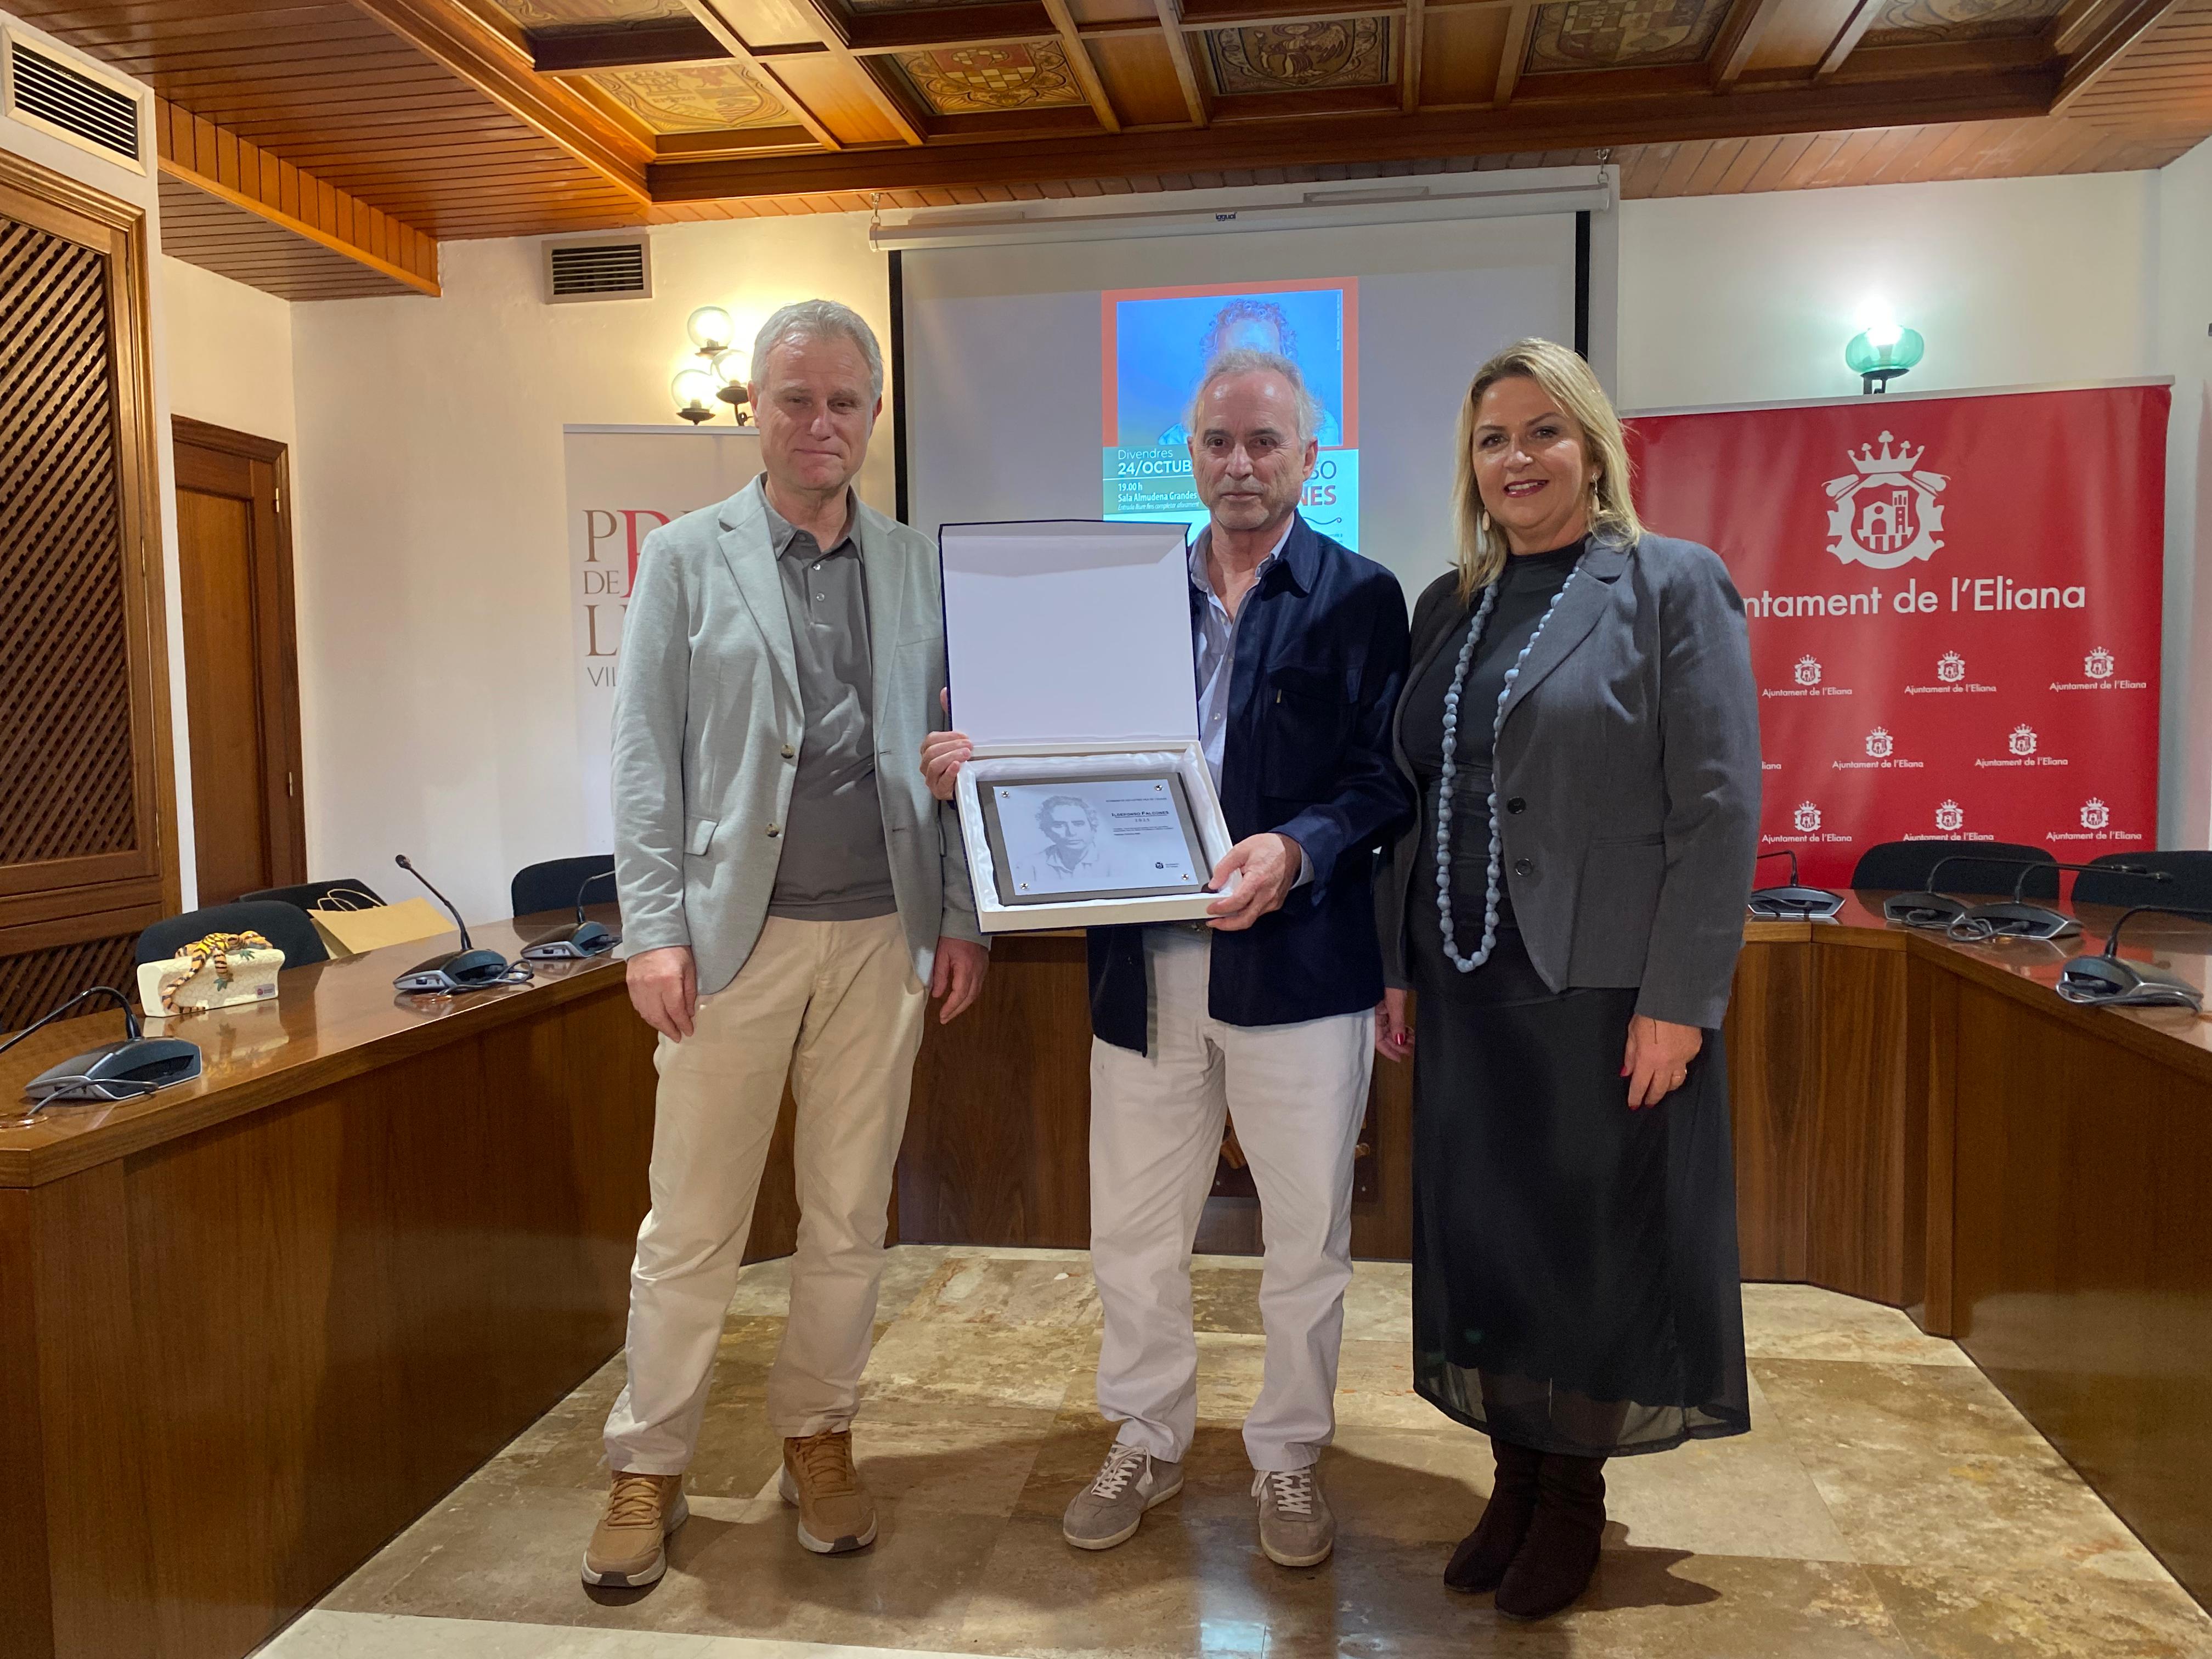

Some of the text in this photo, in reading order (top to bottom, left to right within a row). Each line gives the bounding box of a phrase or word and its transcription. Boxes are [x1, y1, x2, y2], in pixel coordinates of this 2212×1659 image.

[1118, 448, 1173, 460] Divendres
[1118, 460, 1192, 476] 24/OCTUB
[1118, 482, 1143, 492] 19.00 h
[1118, 490, 1197, 503] Sala Almudena Grandes
[584, 570, 620, 595] DE
[1893, 578, 1938, 613] de
[1904, 685, 1950, 695] Ajuntament
[1952, 684, 1963, 692] de
[2049, 682, 2098, 692] Ajuntament
[2100, 680, 2112, 689] de
[1762, 689, 1808, 698] Ajuntament
[1809, 687, 1820, 695] de
[1832, 760, 1879, 770] Ajuntament
[1881, 759, 1892, 768] de
[1975, 759, 2022, 769] Ajuntament
[2024, 757, 2035, 766] de
[1762, 834, 1808, 844] Ajuntament
[1809, 833, 1820, 842] de
[1950, 832, 1961, 840] de
[2046, 832, 2094, 842] Ajuntament
[2095, 831, 2107, 839] de
